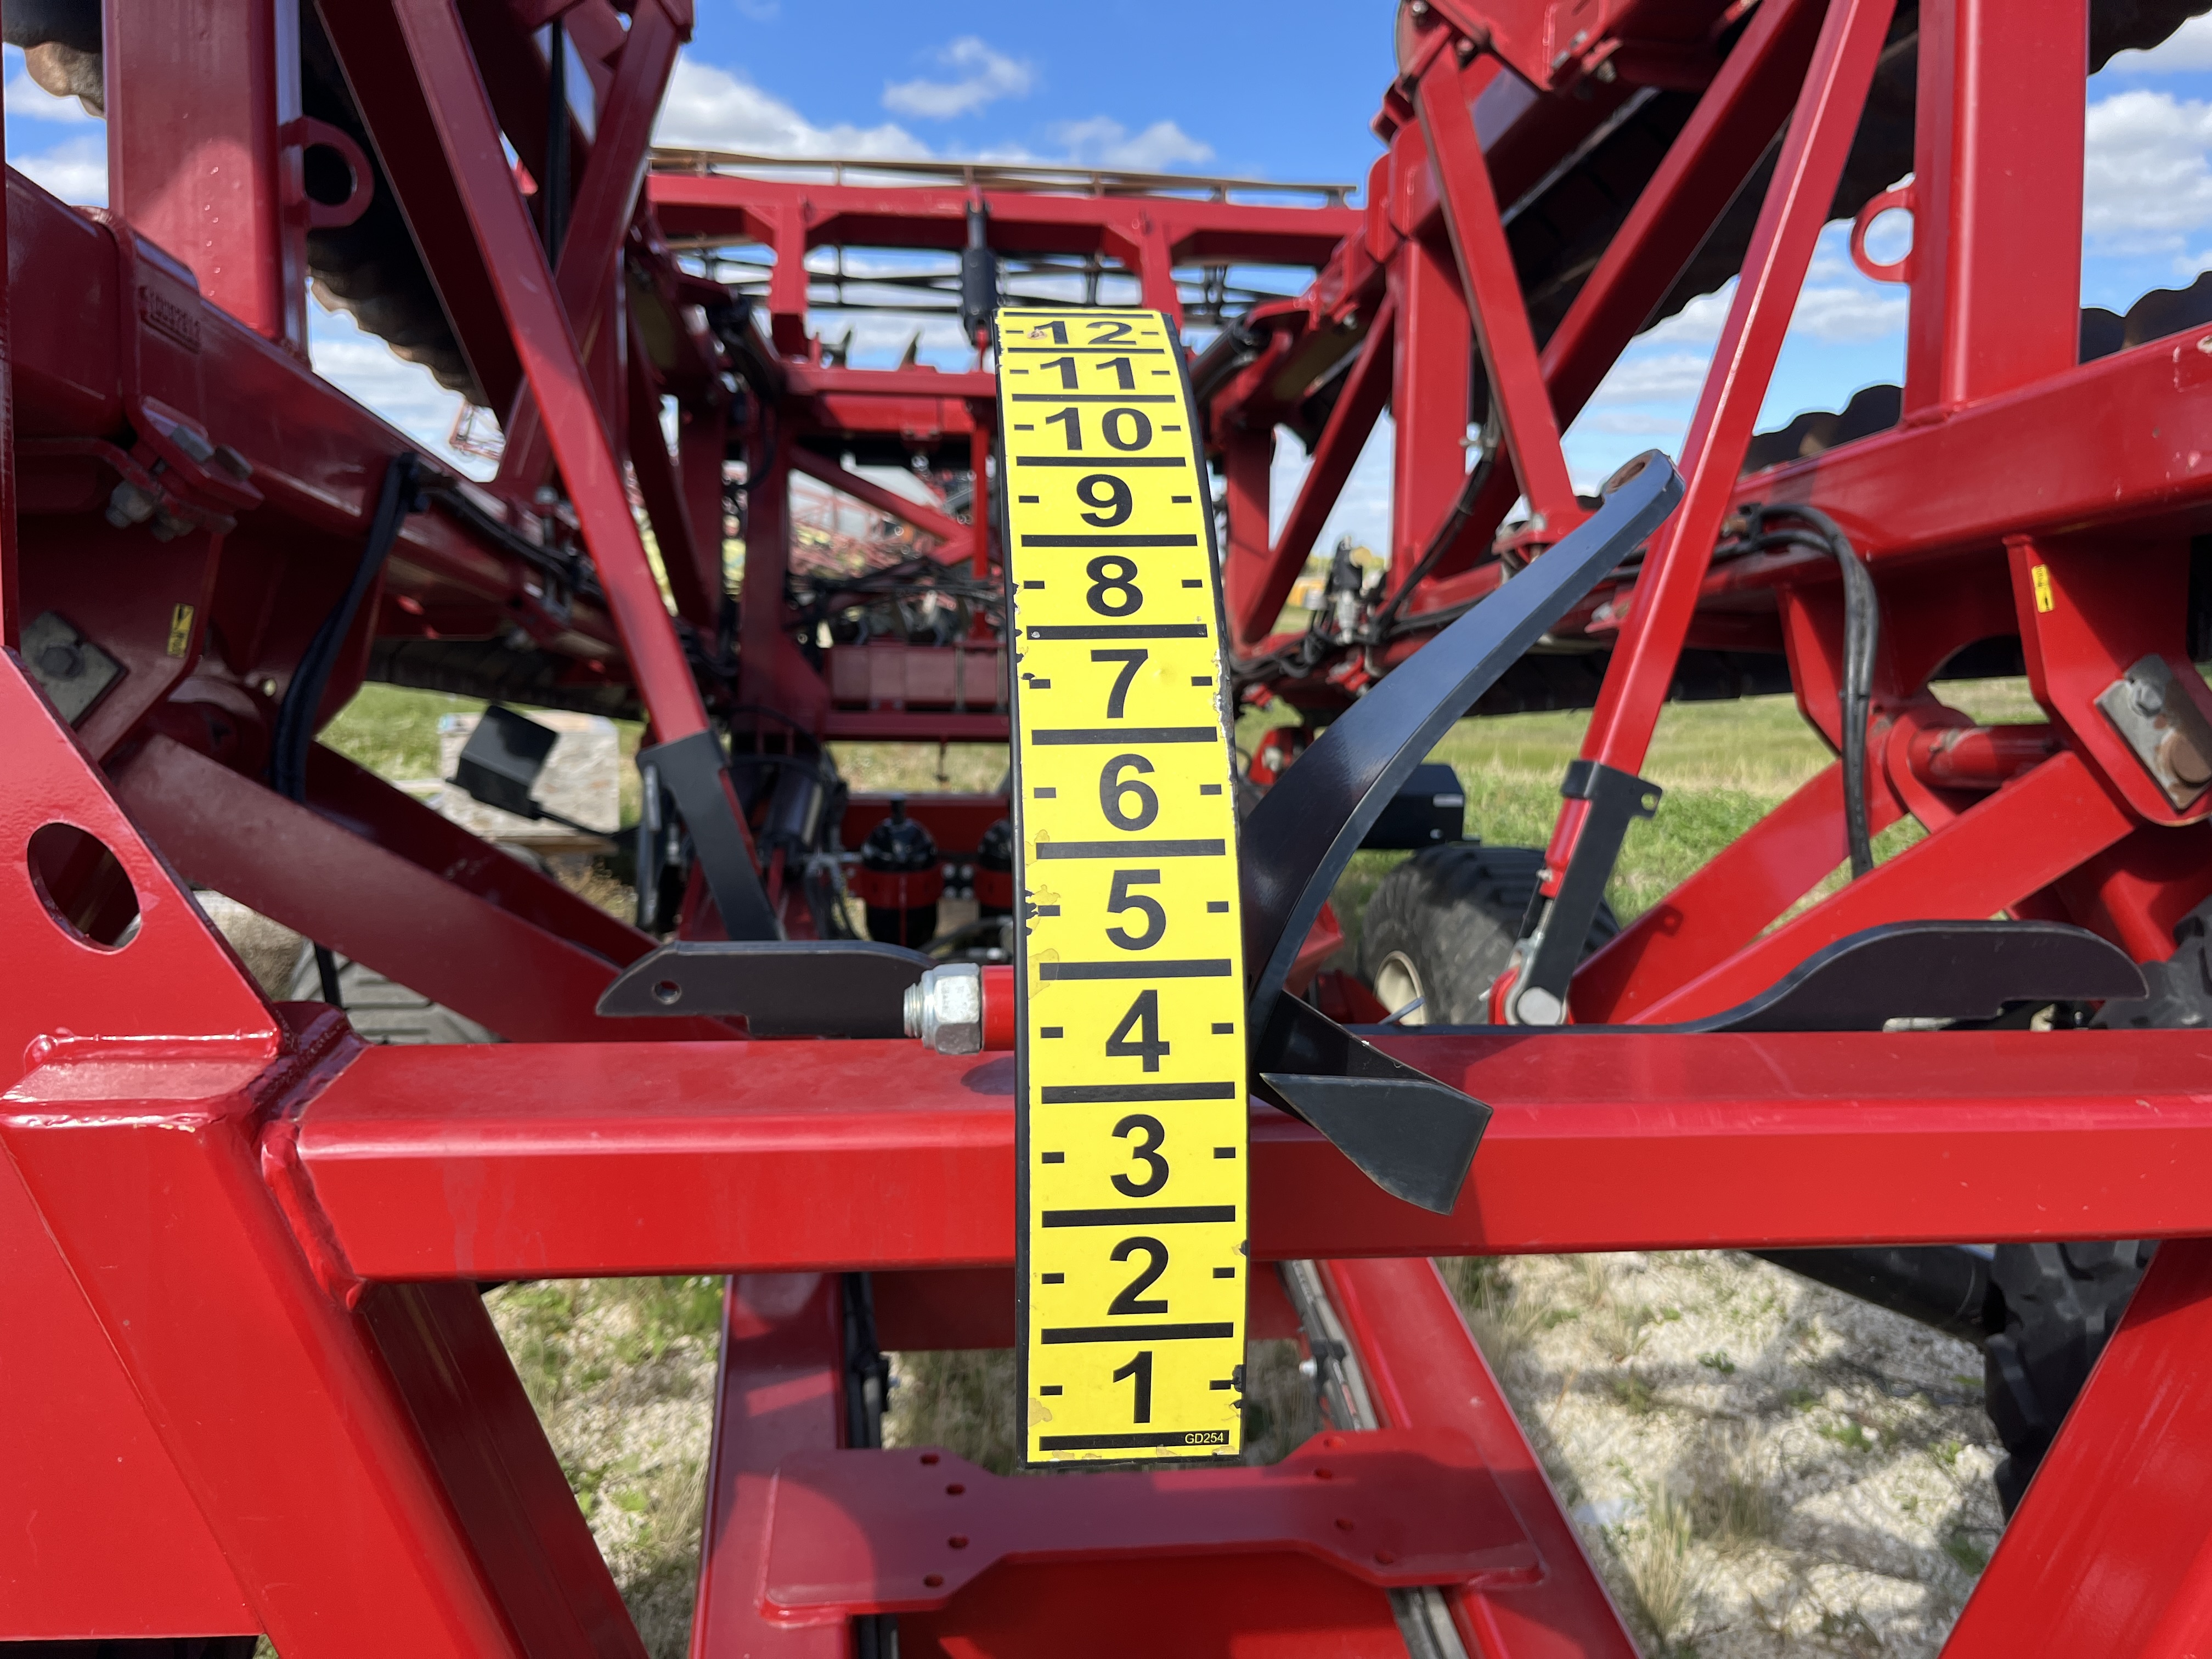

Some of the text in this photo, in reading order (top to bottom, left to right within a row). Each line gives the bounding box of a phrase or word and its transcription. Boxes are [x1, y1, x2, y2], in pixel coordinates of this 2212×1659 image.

[1034, 320, 1137, 346] 12
[1040, 357, 1136, 390] 11
[1046, 407, 1153, 452] 10
[1076, 474, 1133, 528] 9
[1086, 555, 1144, 618] 8
[1091, 649, 1148, 719] 7
[1099, 753, 1159, 832] 6
[1106, 870, 1167, 951] 5
[1106, 990, 1170, 1073] 4
[1110, 1114, 1170, 1198] 3
[1107, 1237, 1169, 1316] 2
[1113, 1351, 1153, 1424] 1
[1184, 1432, 1223, 1444] GD254
